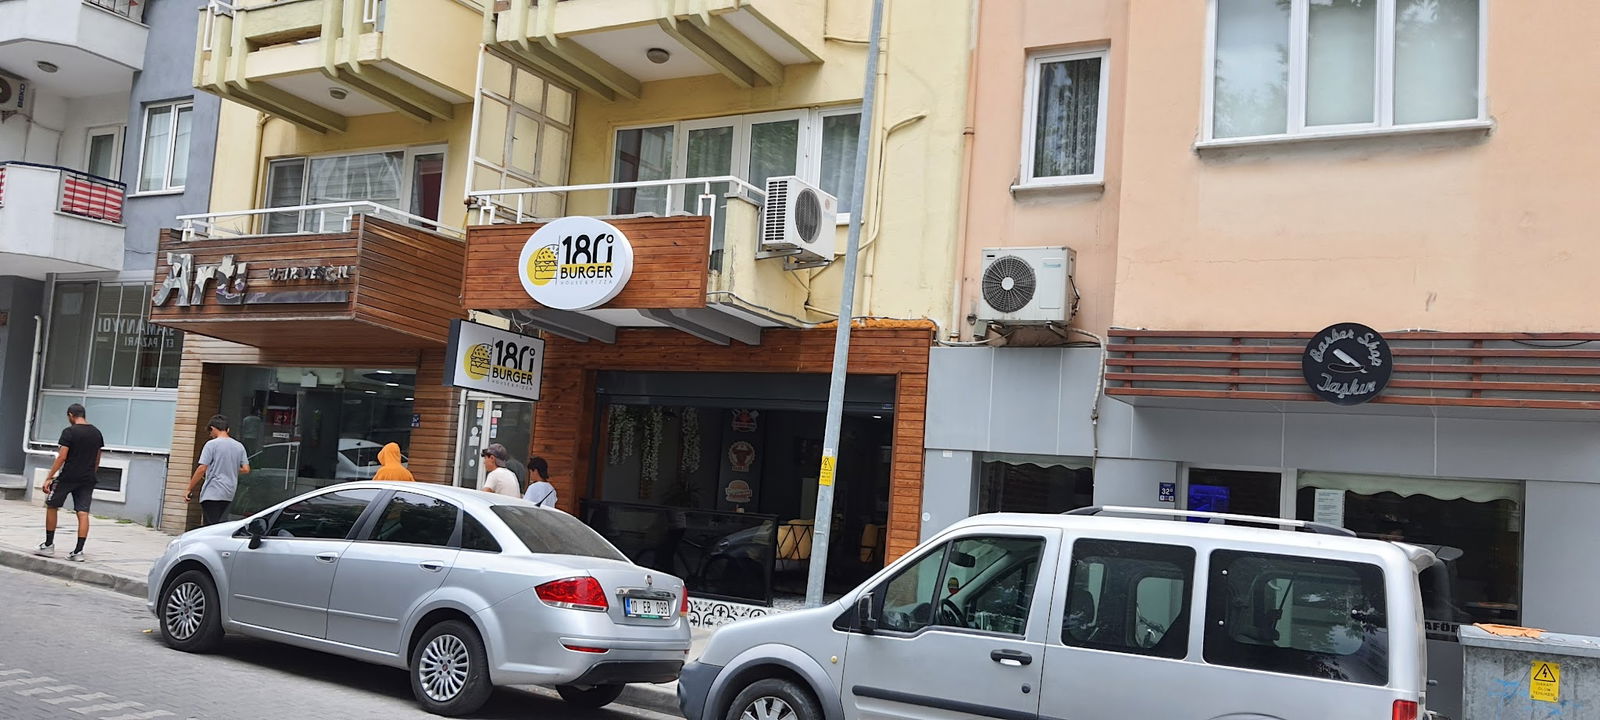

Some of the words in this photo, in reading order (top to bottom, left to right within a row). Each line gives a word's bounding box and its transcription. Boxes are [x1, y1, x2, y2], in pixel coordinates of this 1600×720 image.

[560, 265, 613, 279] BURGER
[1309, 328, 1355, 362] Barber
[1357, 332, 1383, 366] Shop
[492, 367, 533, 386] BURGER
[630, 600, 638, 613] 10
[643, 601, 651, 613] EB
[656, 601, 667, 614] 098
